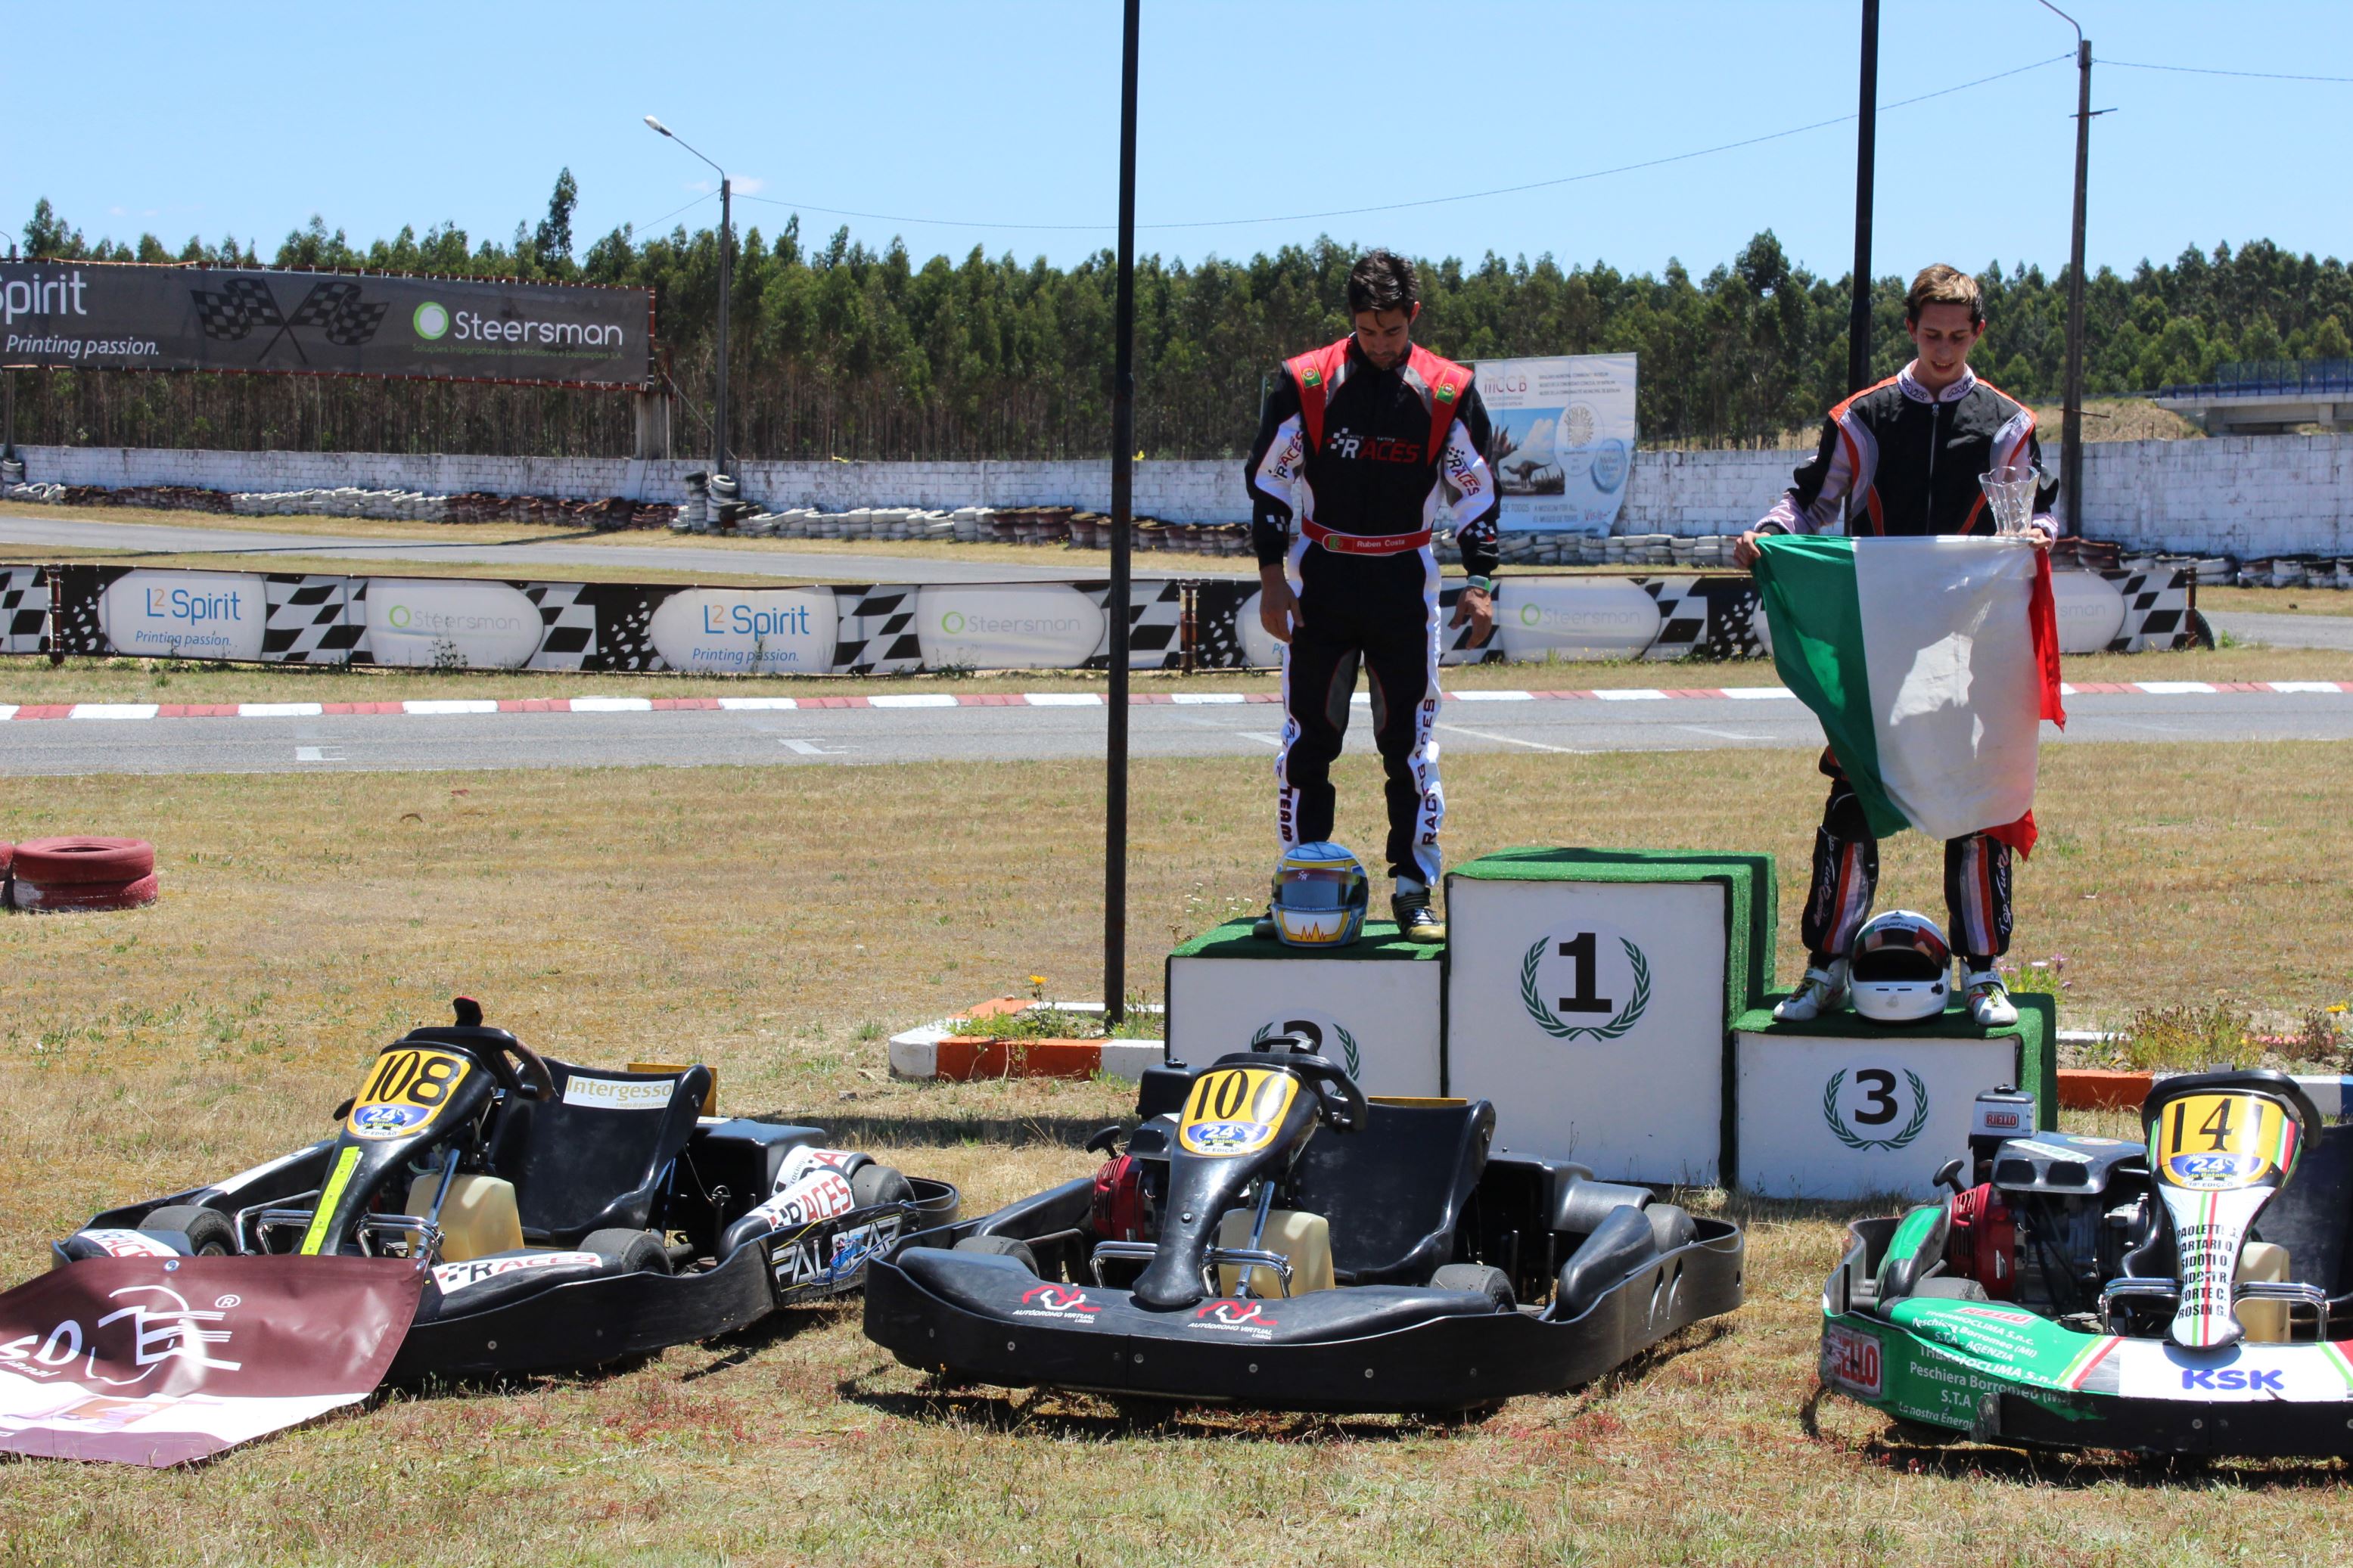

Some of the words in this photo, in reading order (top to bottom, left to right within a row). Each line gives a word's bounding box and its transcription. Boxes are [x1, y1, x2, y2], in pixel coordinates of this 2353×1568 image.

[0, 271, 87, 324] pirit
[455, 310, 623, 346] Steersman
[6, 334, 81, 359] Printing
[83, 337, 160, 360] passion.
[1357, 540, 1382, 548] Ruben
[172, 589, 241, 626] Spirit
[1543, 608, 1641, 625] Steersman
[415, 611, 521, 631] Steersman
[732, 605, 810, 642] Spirit
[969, 616, 1080, 633] Steersman
[135, 630, 182, 646] Printing
[185, 632, 232, 647] passion.
[692, 647, 744, 665] Printing
[746, 649, 800, 664] passion.
[1279, 786, 1294, 843] TEAM
[1559, 932, 1612, 1014] 1
[365, 1051, 462, 1107] 108
[567, 1076, 673, 1101] Intergesso
[1194, 1068, 1288, 1123] 100
[1854, 1068, 1898, 1126] 3
[366, 1109, 396, 1122] 24
[1986, 1113, 2017, 1126] RIELLO
[1204, 1126, 1236, 1139] 24
[2191, 1158, 2225, 1172] 24
[2183, 1271, 2216, 1285] IDOTI
[2216, 1287, 2227, 1302] C.
[1012, 1309, 1063, 1318] AUTÓDROMO
[1064, 1312, 1096, 1321] VIRTUAL
[1960, 1308, 2031, 1323] RIELLO
[1187, 1322, 1240, 1331] AUTÓDROMO
[1240, 1325, 1273, 1336] VIRTUAL
[1912, 1317, 1958, 1334] Peschiera
[1959, 1325, 2013, 1349] Borromeo
[2014, 1342, 2038, 1359] (MI)
[1926, 1310, 2005, 1336] THERMOCLIMA
[2006, 1330, 2034, 1346] S.n.c.
[1829, 1332, 1879, 1387] IELLO
[1965, 1340, 2015, 1362] AGENZIA
[1910, 1361, 1967, 1386] Peschiera
[2181, 1368, 2285, 1391] KSK
[1941, 1389, 1972, 1408] S.T.A
[1898, 1402, 1907, 1411] La
[1910, 1408, 1939, 1421] nostra
[1941, 1412, 1976, 1430] Energi
